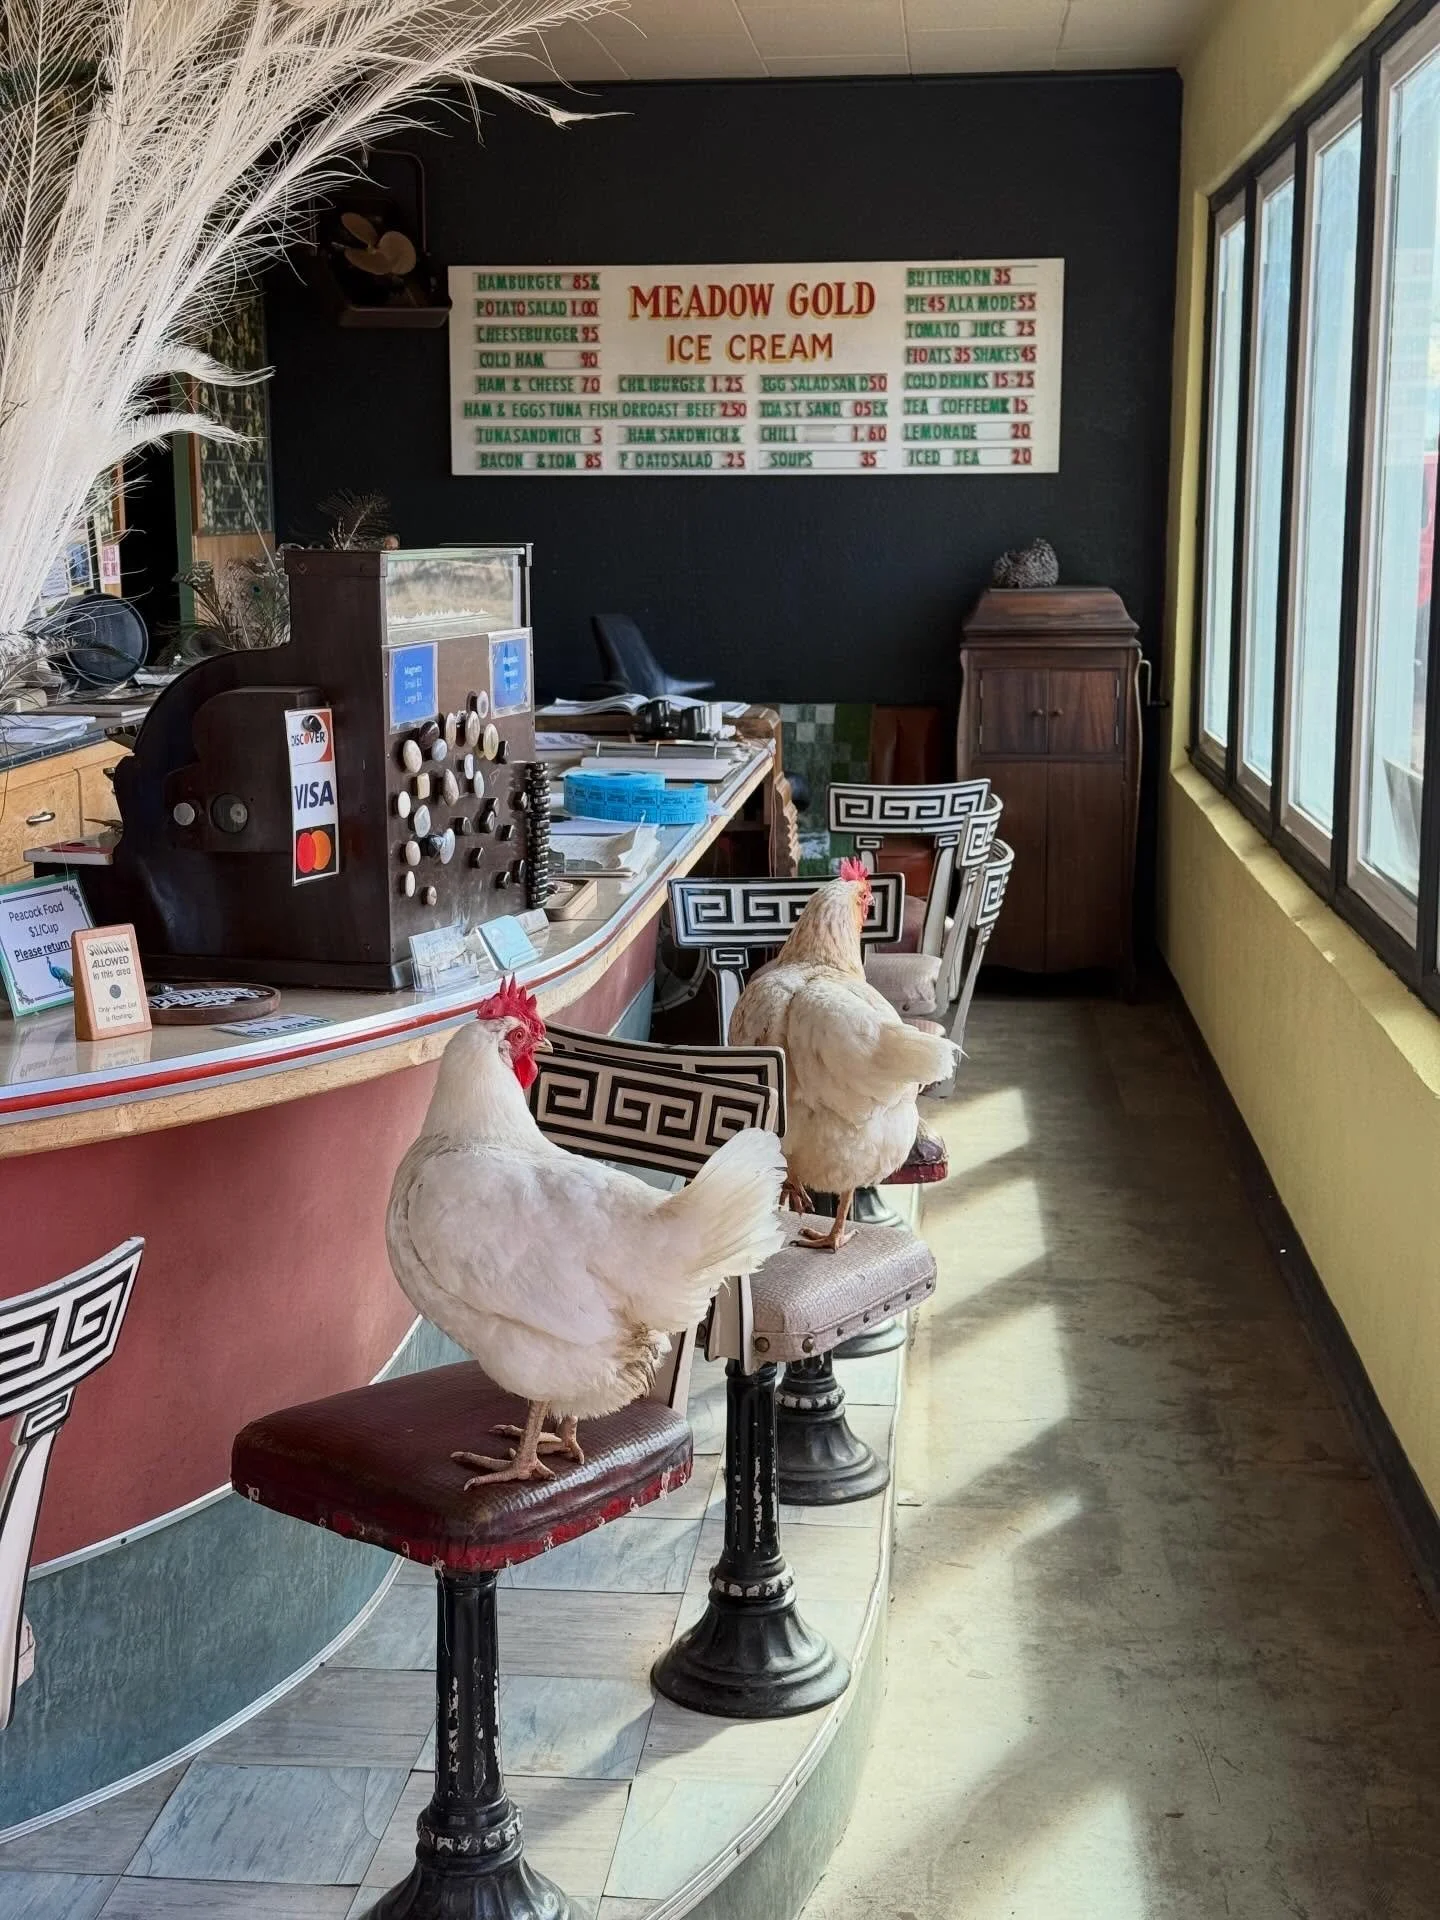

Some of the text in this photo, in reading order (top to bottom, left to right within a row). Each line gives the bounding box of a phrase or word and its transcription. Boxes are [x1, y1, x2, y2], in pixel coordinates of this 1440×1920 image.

[477, 274, 562, 290] HAMBURGER
[907, 268, 1011, 286] BUTTERHORN 35
[628, 281, 876, 320] MEADOW GOLD
[907, 295, 926, 312] PIE
[927, 294, 945, 311] 45
[1018, 292, 1036, 309] 55
[477, 327, 599, 342] CHEESEBURGER 95
[907, 322, 960, 338] TOMATO
[1016, 320, 1035, 336] 25
[667, 333, 833, 363] ICE CREAM
[955, 346, 971, 363] 35
[973, 346, 1019, 363] SHAKES
[1021, 345, 1036, 362] 45
[479, 352, 598, 368] COLD HAM 90
[477, 377, 600, 392] HAM & CHEESE 70
[762, 375, 786, 392] EGG
[464, 403, 492, 417] HAM
[497, 403, 505, 417] &
[512, 403, 545, 417] EGGS
[549, 403, 582, 417] TUNA
[590, 403, 618, 417] FISH
[686, 403, 716, 417] BEEF
[904, 398, 929, 414] TEA
[1013, 398, 1028, 413] 15
[593, 428, 602, 443] 5
[627, 427, 656, 442] HAM
[660, 427, 728, 442] SANDWICH
[761, 426, 798, 440] CHILI
[904, 424, 1031, 440] LEMONADE 20
[480, 453, 523, 468] BACON
[584, 453, 602, 468] 85
[770, 452, 877, 467] SOUPS 35
[908, 448, 1031, 466] ICED TEA 20
[291, 731, 326, 747] DISCOVER
[294, 780, 335, 811] VISA
[9, 901, 65, 922] Peacock Food
[28, 923, 59, 938] $1/Cup
[15, 939, 70, 961] Please return
[91, 955, 130, 968] ALLOWED
[93, 967, 131, 980] in this area
[281, 1018, 331, 1029] each
